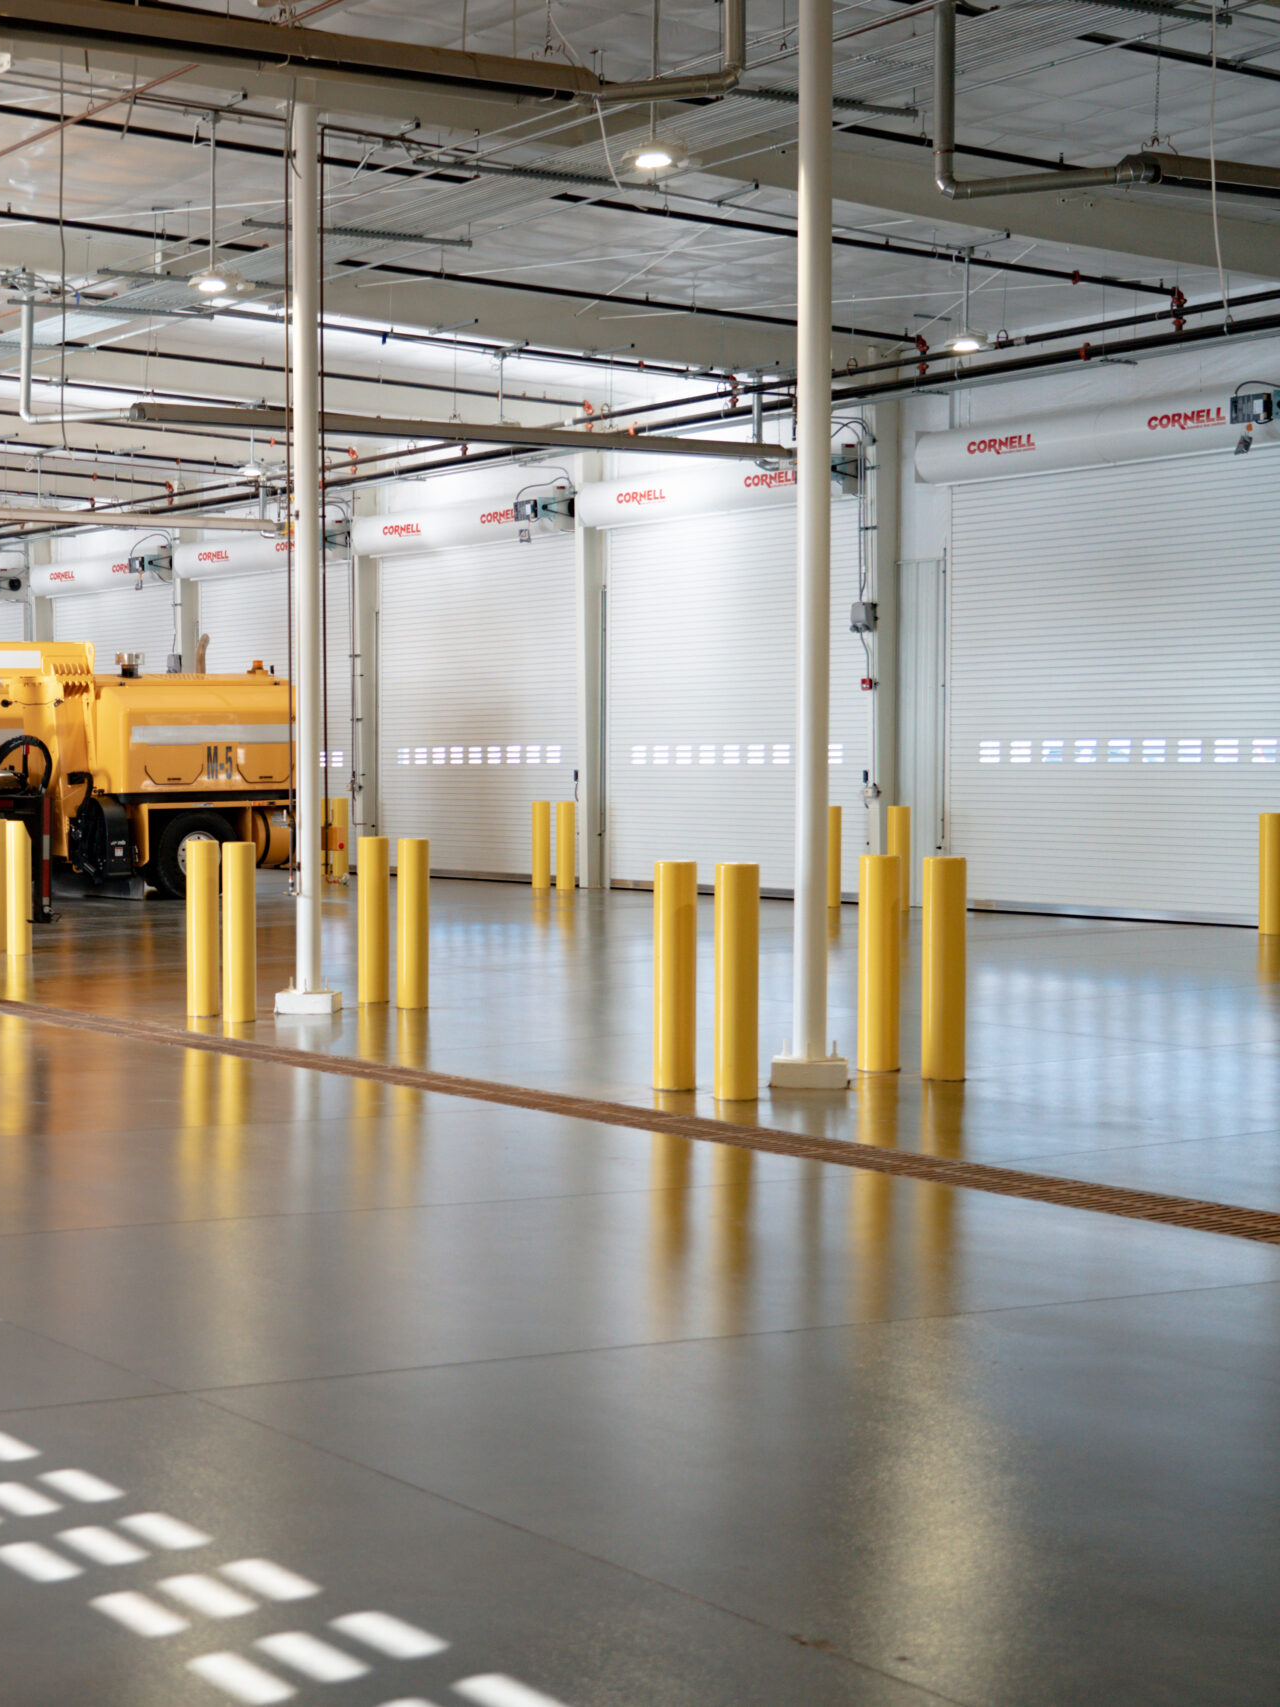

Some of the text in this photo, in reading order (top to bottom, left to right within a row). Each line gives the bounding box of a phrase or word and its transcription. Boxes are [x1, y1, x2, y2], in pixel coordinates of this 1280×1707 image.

[1148, 407, 1226, 430] CORNELL
[967, 433, 1035, 455] CORNELL
[616, 488, 666, 505] CORNELL
[480, 509, 515, 524] CORNEL
[382, 523, 421, 537] CORNELL
[197, 550, 229, 563] CORNELL
[49, 570, 75, 582] CORNELL
[207, 746, 233, 779] M-5
